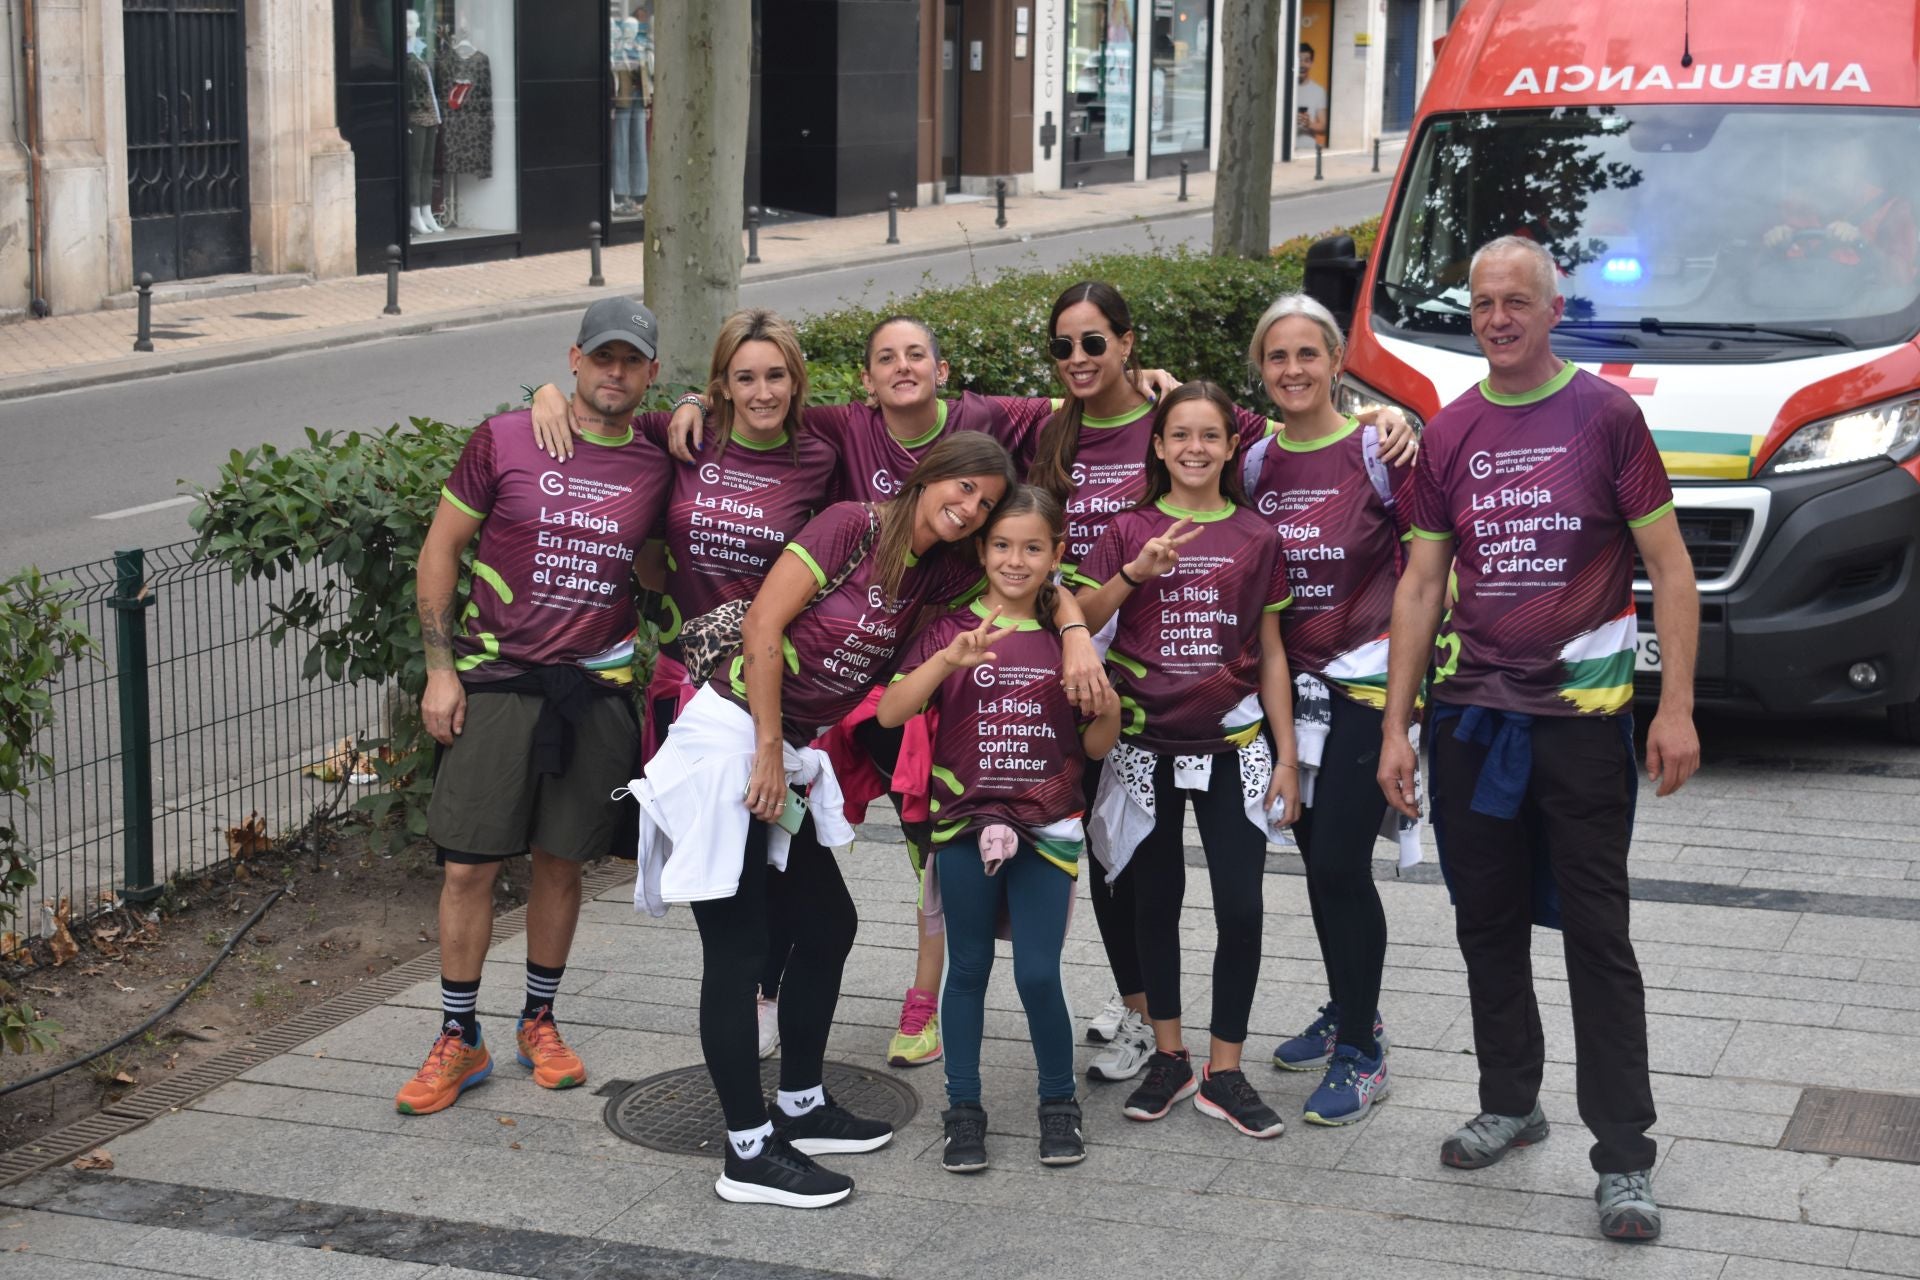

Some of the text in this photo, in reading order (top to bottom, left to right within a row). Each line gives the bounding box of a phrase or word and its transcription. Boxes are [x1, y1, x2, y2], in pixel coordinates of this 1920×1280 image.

[1495, 458, 1518, 466] contra
[1515, 464, 1533, 473] Rioja
[568, 484, 590, 492] contra
[587, 493, 604, 502] Rioja
[695, 492, 764, 519] La Rioja
[1066, 497, 1085, 513] La
[1472, 485, 1552, 511] La Rioja
[540, 506, 619, 535] La Rioja
[690, 511, 785, 543] En marcha
[1069, 521, 1088, 537] En
[1473, 512, 1582, 538] En marcha
[689, 529, 746, 549] contra
[1277, 523, 1320, 541] Rioja
[537, 530, 634, 562] En marcha
[689, 542, 768, 568] el cáncer
[1478, 536, 1537, 557] contra
[534, 552, 598, 574] contra
[1496, 555, 1568, 573] cáncer
[532, 568, 617, 596] el cáncer
[1288, 582, 1335, 598] ncer
[1160, 588, 1179, 603] La
[857, 613, 876, 634] La
[1161, 609, 1180, 624] En
[843, 632, 863, 650] En
[1160, 624, 1213, 640] contra
[833, 648, 871, 668] contra
[1160, 641, 1224, 657] el cáncr
[823, 657, 840, 673] el
[978, 698, 1042, 718] La Rioja
[978, 721, 998, 736] En
[978, 738, 1029, 753] contra
[979, 754, 1047, 771] el cáncer
